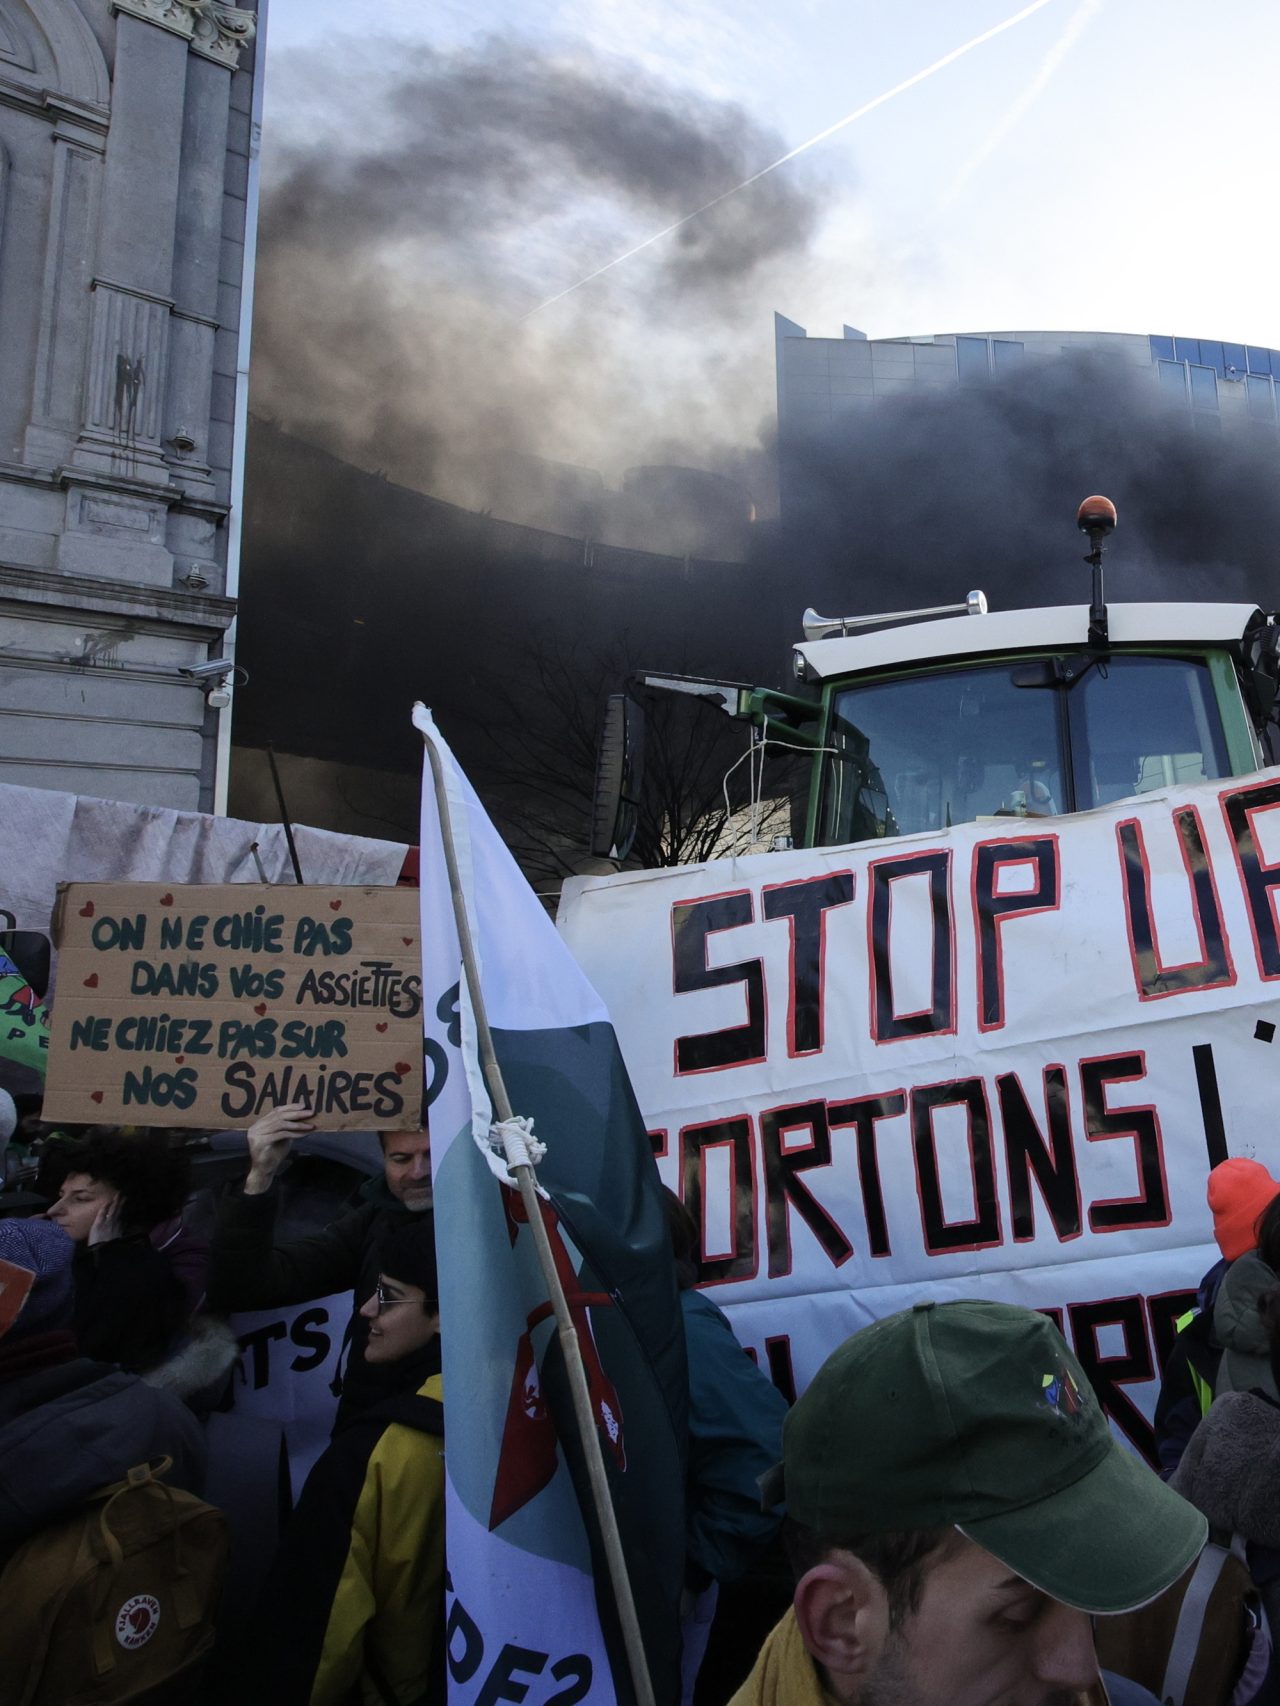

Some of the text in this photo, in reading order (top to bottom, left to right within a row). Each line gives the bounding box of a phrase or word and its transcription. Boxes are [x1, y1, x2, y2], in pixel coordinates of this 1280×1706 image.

[92, 914, 146, 951] ON
[160, 915, 209, 951] NE
[294, 917, 353, 956] PAS
[673, 834, 1061, 1076] STOP
[131, 960, 219, 999] DANS
[70, 1016, 112, 1051] NE
[218, 1018, 278, 1059] PAS
[279, 1019, 348, 1059] SUR
[122, 1066, 198, 1109] NOS
[647, 1050, 1171, 1289] ORTONS
